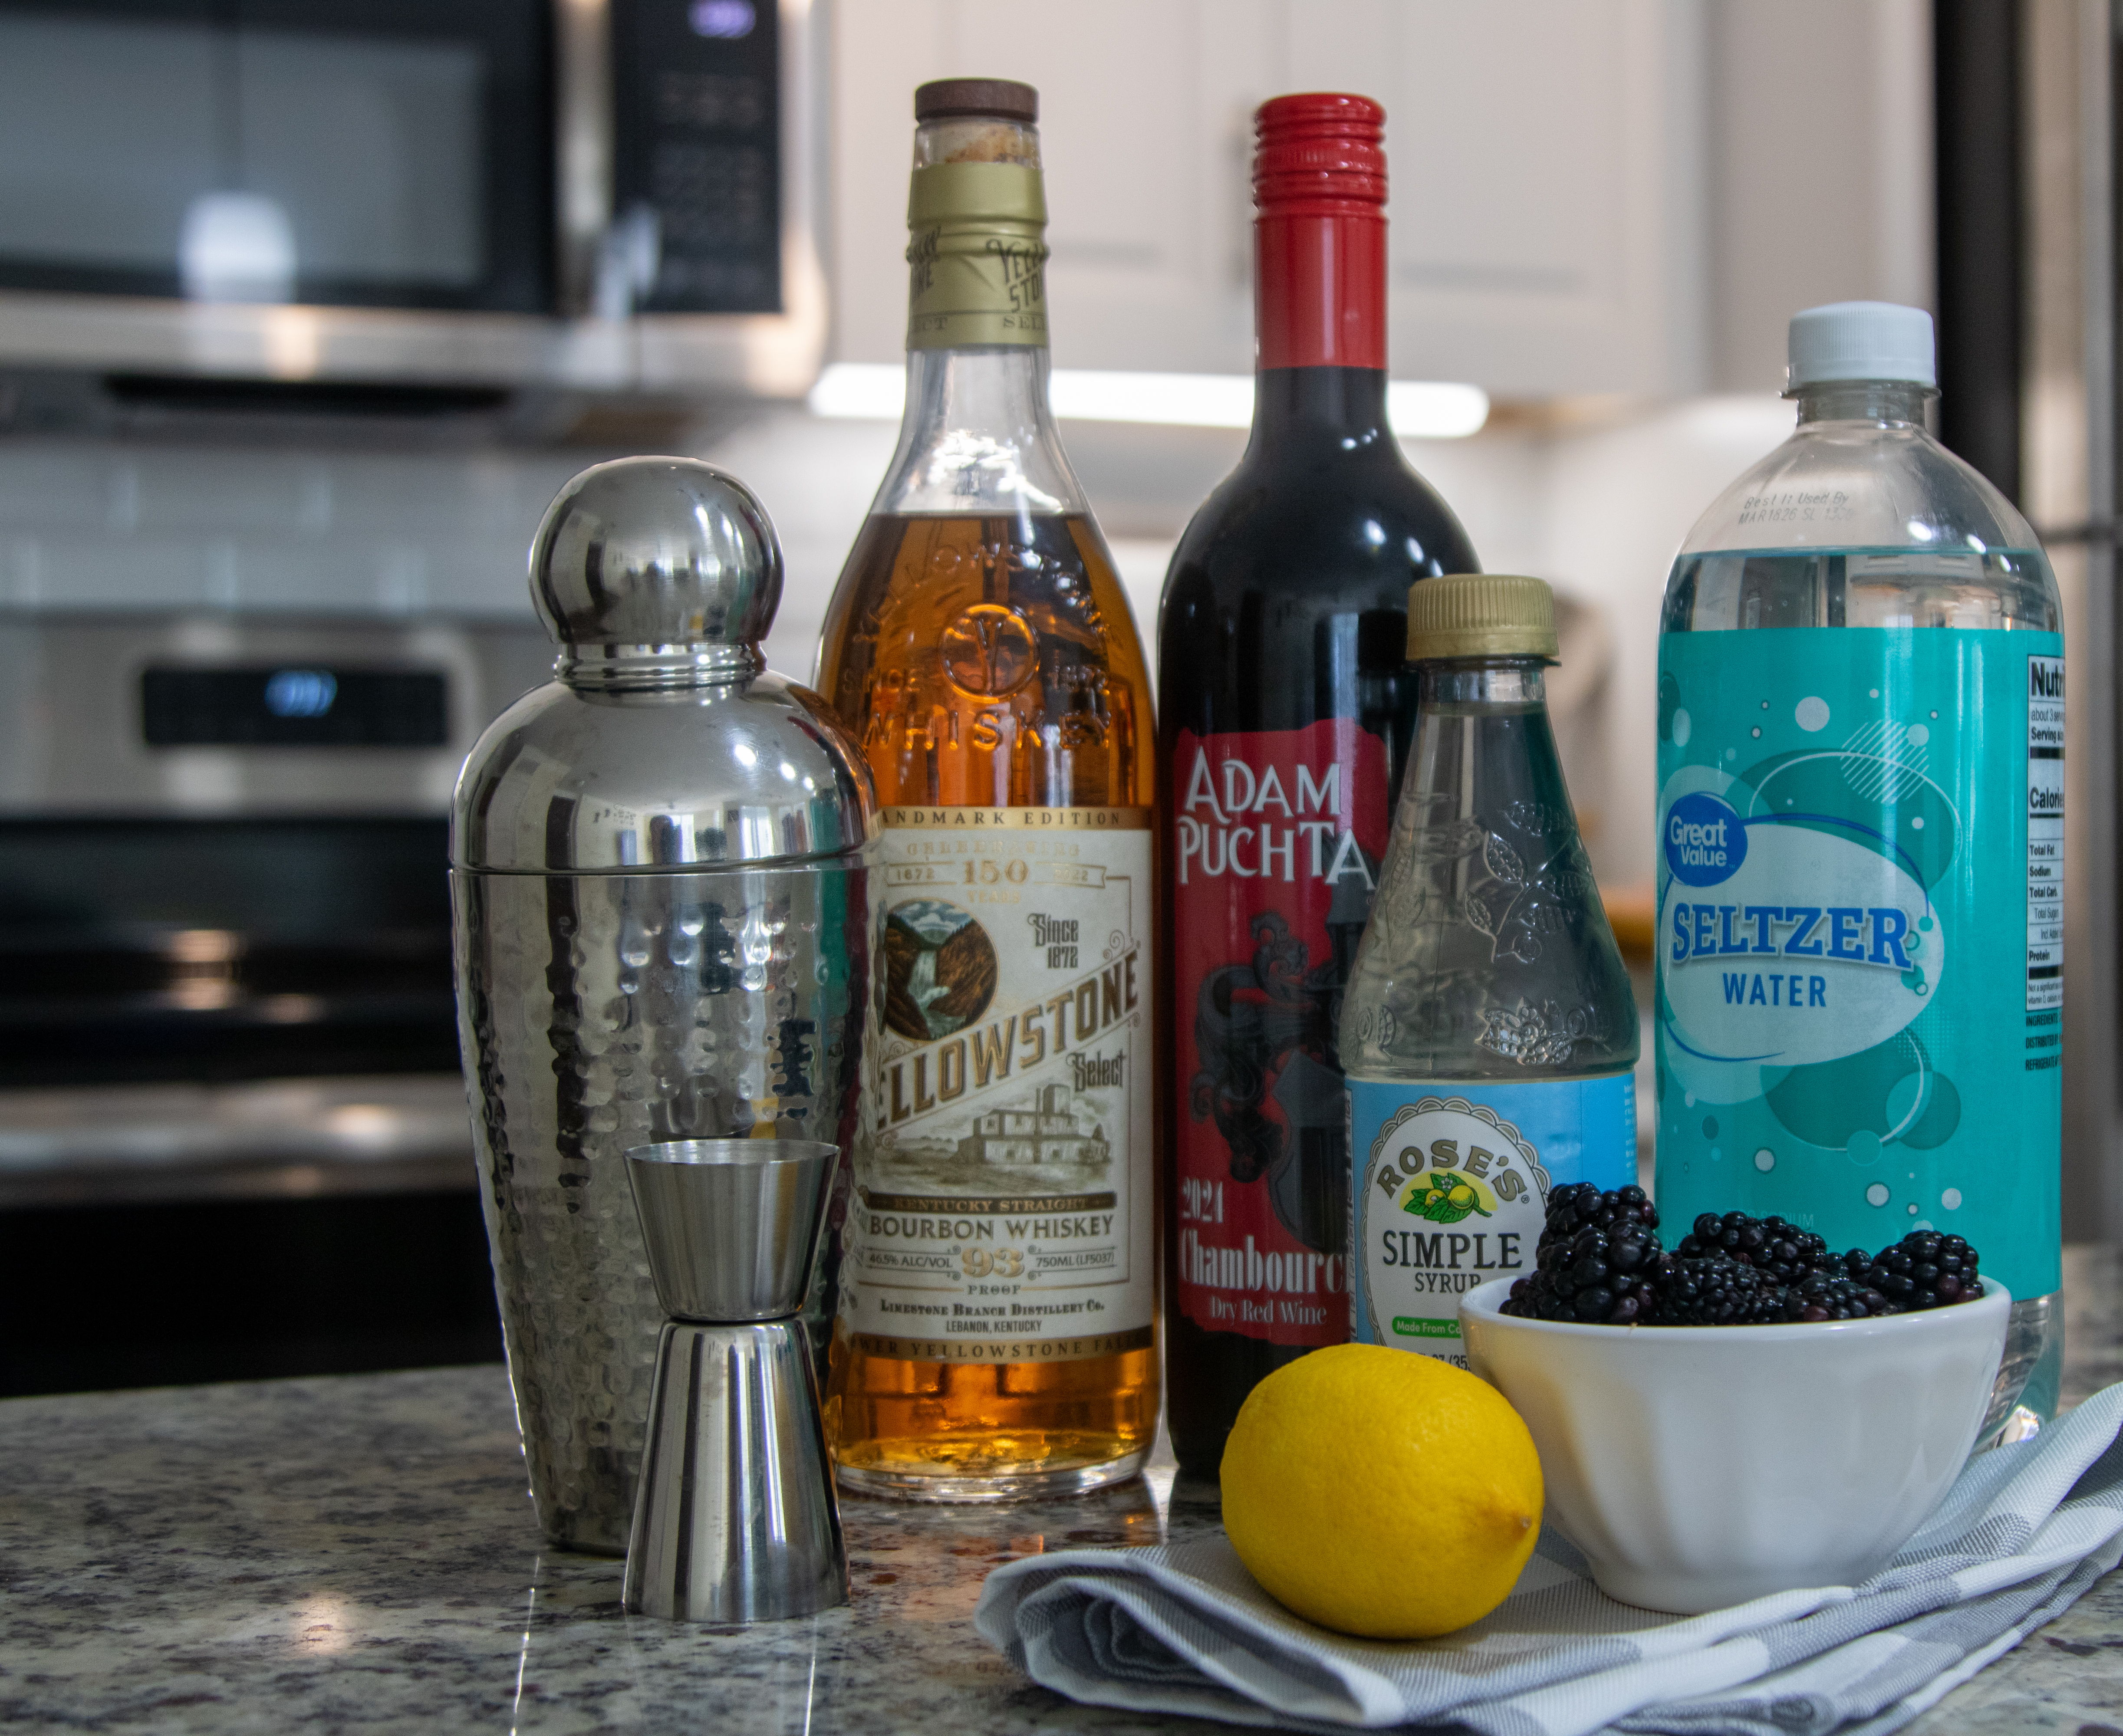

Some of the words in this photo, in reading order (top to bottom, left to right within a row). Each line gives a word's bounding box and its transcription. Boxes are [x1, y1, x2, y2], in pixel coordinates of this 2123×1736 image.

[1744, 494, 1777, 509] Best
[1798, 492, 1830, 504] Used
[1833, 491, 1849, 506] By
[2031, 707, 2048, 721] about
[2031, 727, 2057, 743] Serving
[1185, 745, 1342, 824] ADAM
[1025, 812, 1120, 825] EDITION
[1671, 815, 1727, 847] Great
[1177, 815, 1376, 890] PUCHTA
[1680, 844, 1727, 867] Value
[2029, 844, 2046, 855] Total
[2047, 844, 2055, 855] Fat
[963, 859, 1028, 884] 150
[2029, 865, 2051, 877] Sodium
[968, 890, 1020, 903] YEARS
[2029, 886, 2045, 898] Total
[2034, 907, 2046, 919] Total
[1027, 913, 1079, 947] Since
[1673, 902, 1914, 972] SELTZER
[1047, 946, 1079, 968] 1872
[2029, 949, 2051, 961] Protein
[1723, 973, 1827, 1007] WATER
[1066, 1047, 1126, 1092] Select
[1377, 1139, 1527, 1202] ROSE'S
[895, 1198, 992, 1211] KENTUCKY
[999, 1198, 1086, 1211] STRAIGHT
[1182, 1177, 1223, 1223] 2021
[870, 1216, 994, 1240] BOURBON
[1005, 1215, 1114, 1239] WHISKEY
[1383, 1230, 1523, 1269] SIMPLE
[901, 1256, 953, 1268] ALC/VOL
[962, 1246, 1025, 1278] 93
[1036, 1256, 1074, 1267] 750ML
[968, 1285, 1021, 1295] PROOF
[1415, 1272, 1481, 1293] SYRUP
[1210, 1295, 1237, 1325] Dry
[1242, 1299, 1274, 1323] Red
[1280, 1300, 1327, 1325] Wine
[946, 1321, 992, 1334] LEBANON,
[994, 1320, 1042, 1333] KENTUCKY
[1397, 1321, 1420, 1332] Made
[1422, 1322, 1445, 1333] From
[911, 1340, 1083, 1358] YELLOWSTONE
